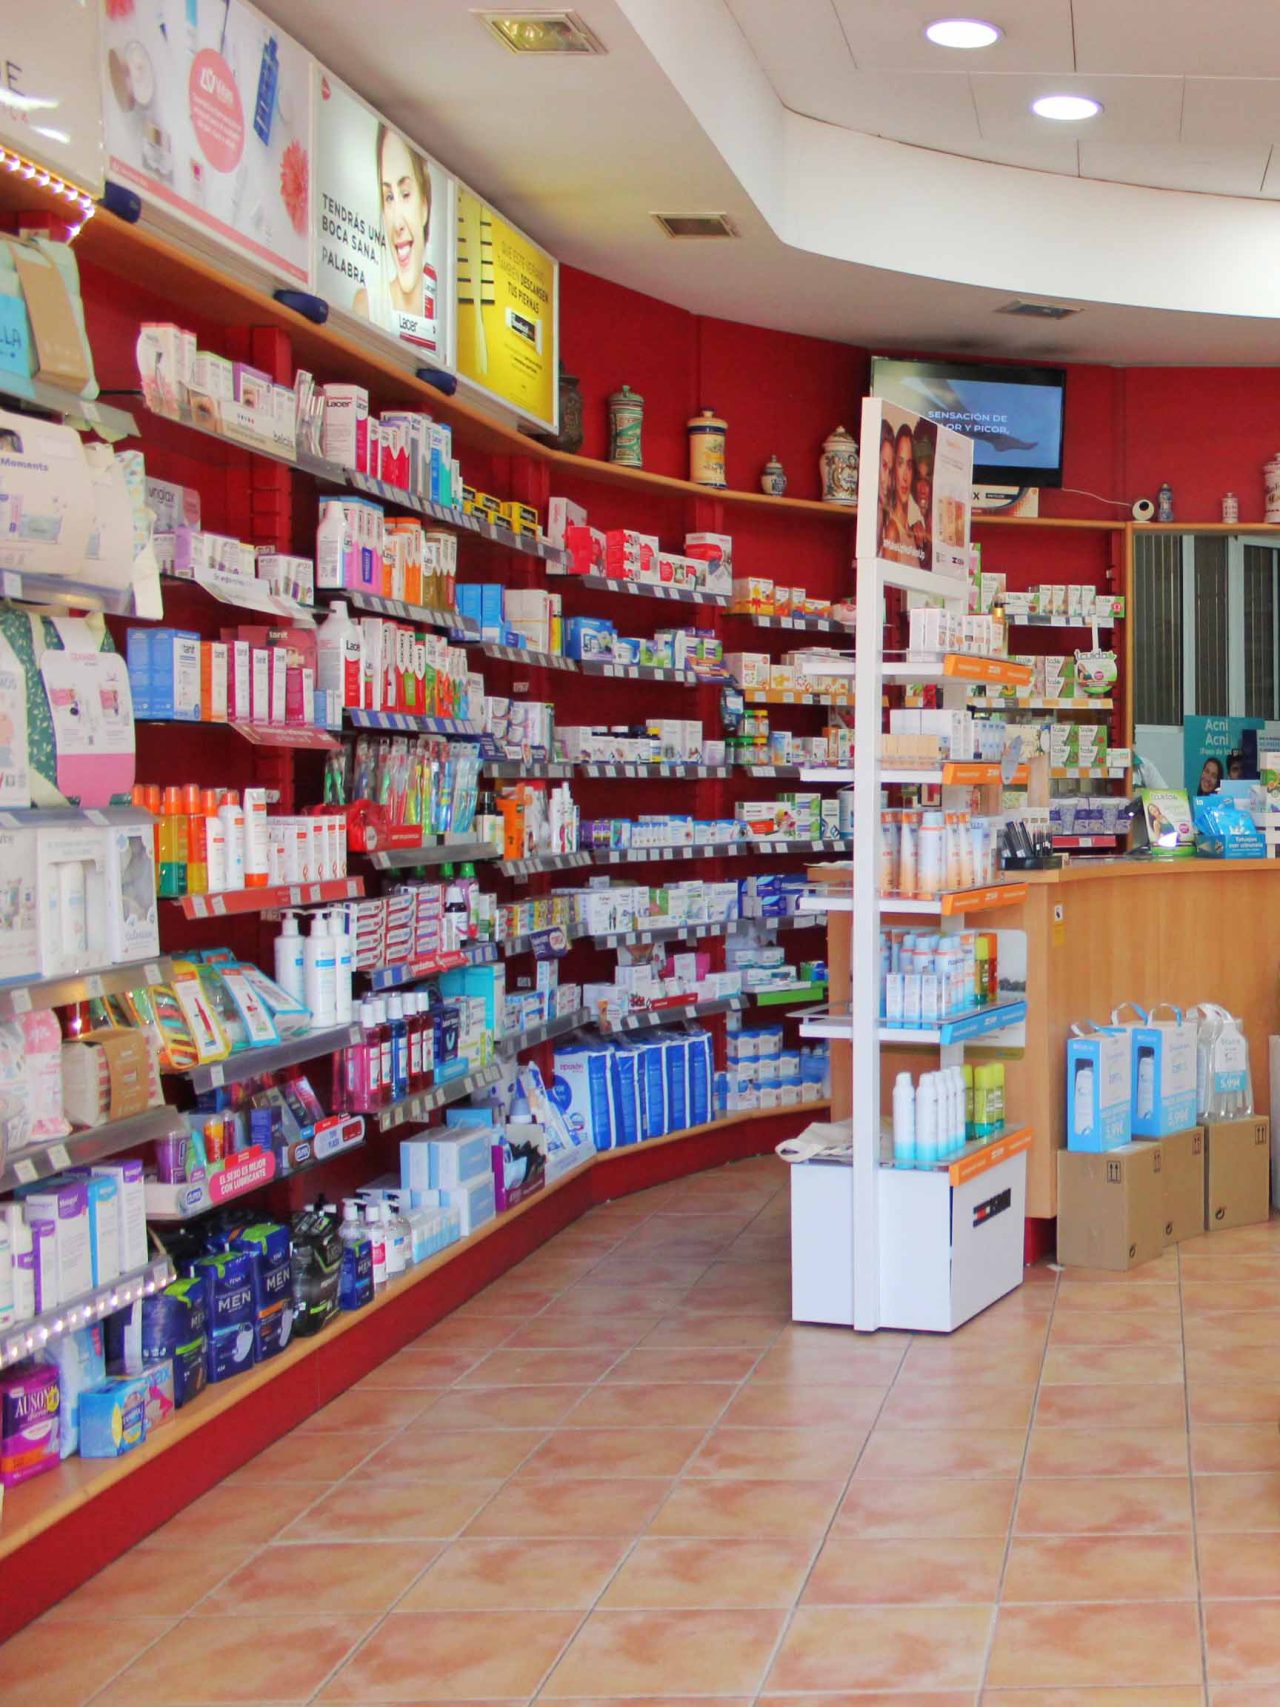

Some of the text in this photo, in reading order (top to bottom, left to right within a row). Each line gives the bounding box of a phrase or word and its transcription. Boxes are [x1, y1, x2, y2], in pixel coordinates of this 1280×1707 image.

[322, 193, 387, 248] TENDRÁS UNA
[322, 214, 349, 243] BOCA
[321, 246, 367, 287] PALABRA
[508, 282, 517, 299] TUS
[399, 314, 418, 333] Lacer
[326, 400, 353, 408] Lacer
[928, 410, 1008, 423] SENSACIÓN DE
[965, 423, 972, 433] Y
[266, 1267, 290, 1292] MEN
[218, 1291, 251, 1313] MEN
